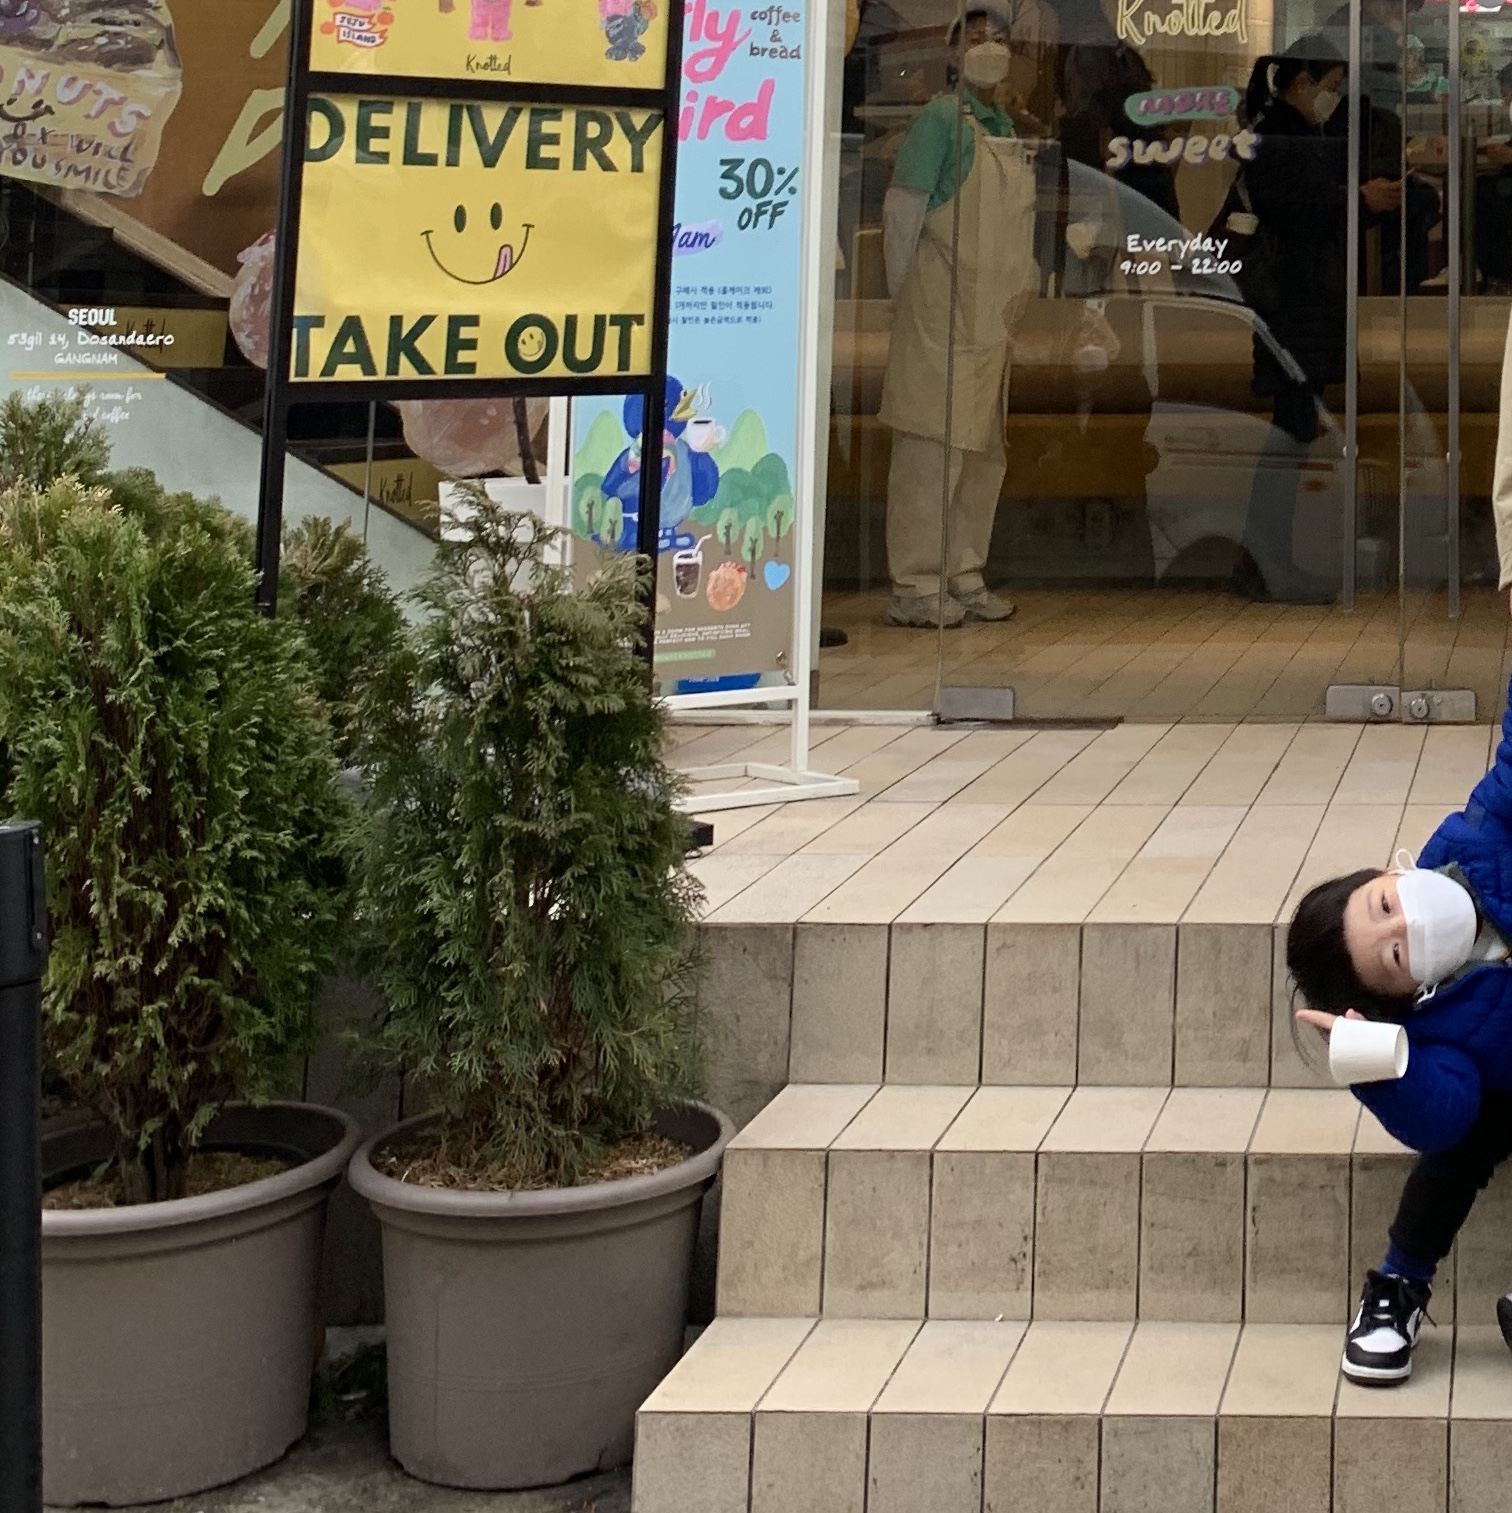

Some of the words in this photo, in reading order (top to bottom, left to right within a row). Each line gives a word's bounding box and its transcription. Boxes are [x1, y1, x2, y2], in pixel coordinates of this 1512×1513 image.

[750, 5, 800, 26] coffee
[769, 28, 783, 44] &
[465, 53, 513, 77] Knotted
[748, 45, 801, 61] bread
[0, 67, 153, 138] NUTS
[679, 79, 775, 141] ird
[304, 98, 664, 173] DELIVERY
[1107, 129, 1263, 169] sweet
[718, 158, 799, 201] 30%
[738, 200, 788, 231] OFF
[1126, 233, 1229, 257] Everyday
[1119, 260, 1162, 275] 9:00
[1191, 258, 1243, 275] 22:00
[67, 308, 118, 326] SEOUL
[77, 330, 175, 346] Dosandaero
[292, 315, 478, 378] TAKE
[503, 312, 645, 374] OUT
[54, 352, 118, 365] GANGNAM
